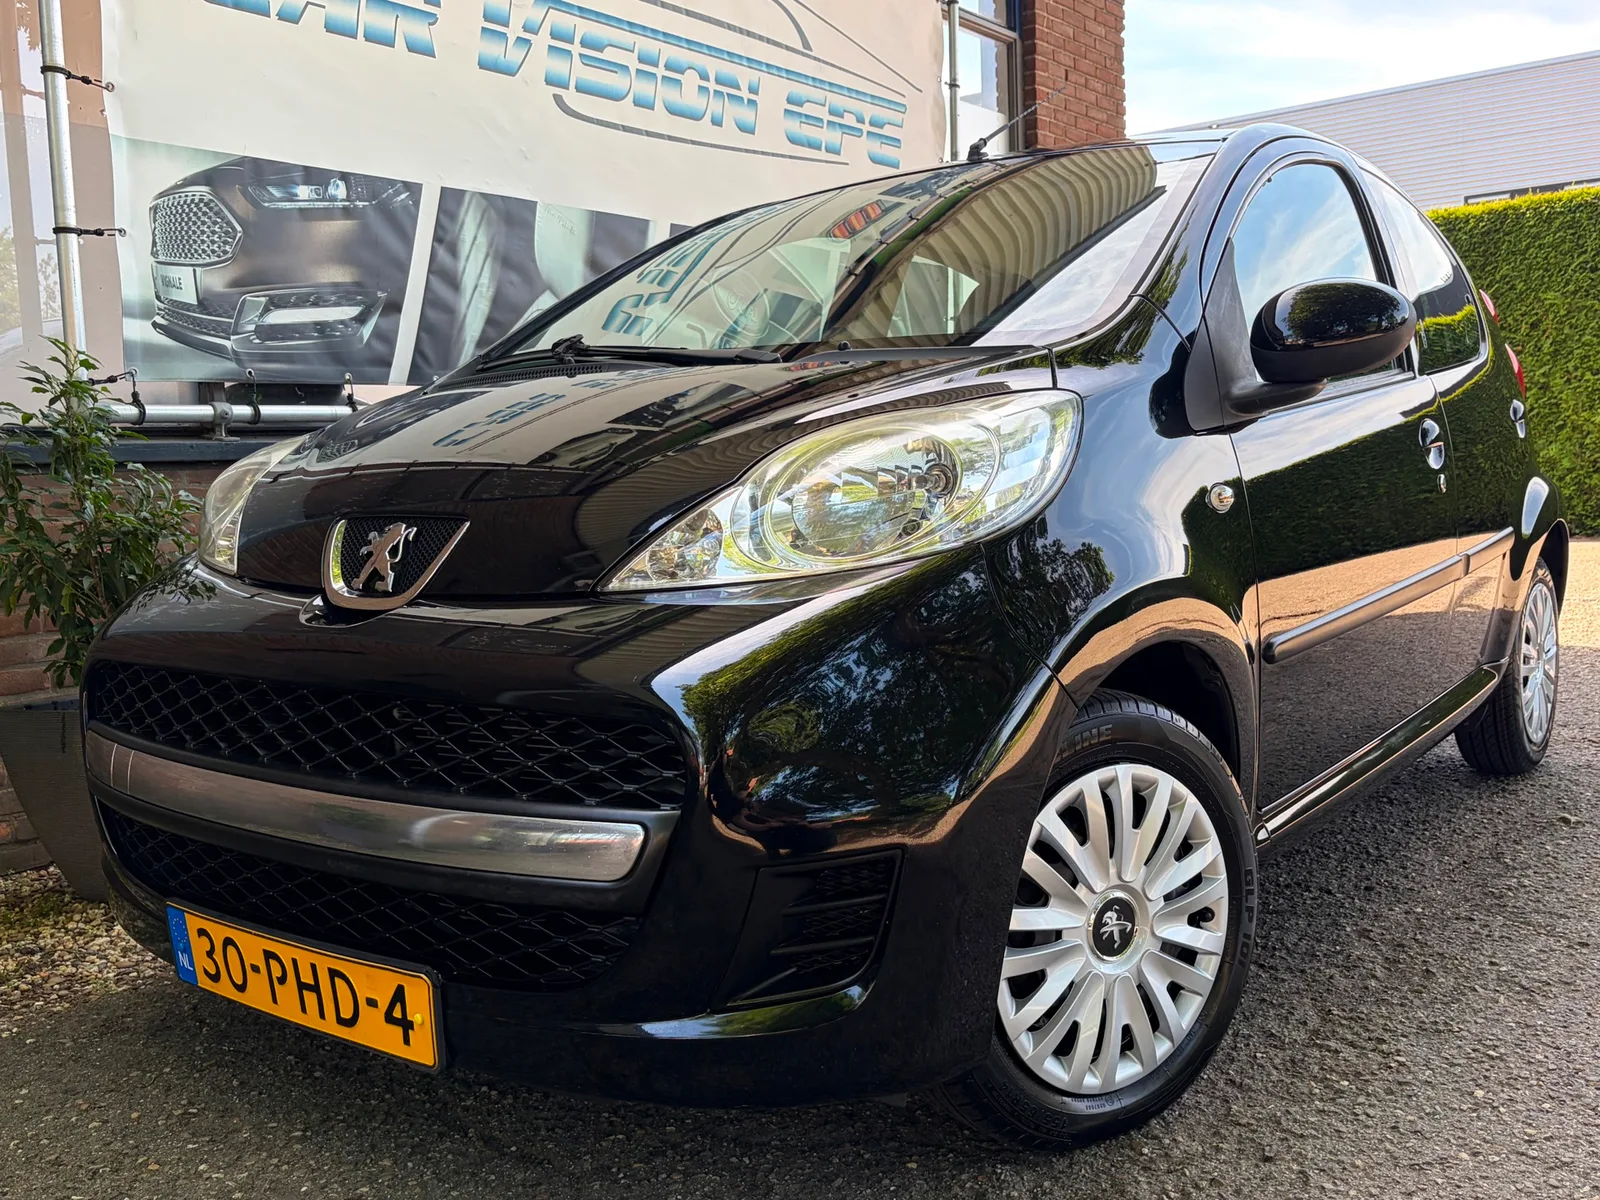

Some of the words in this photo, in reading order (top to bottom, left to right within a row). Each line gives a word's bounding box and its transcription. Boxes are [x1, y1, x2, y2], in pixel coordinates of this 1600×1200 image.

[478, 0, 760, 135] VISION
[783, 90, 904, 169] EPE
[1055, 724, 1112, 763] LINE
[178, 950, 193, 971] NL
[197, 927, 415, 1046] 30-PHD-4
